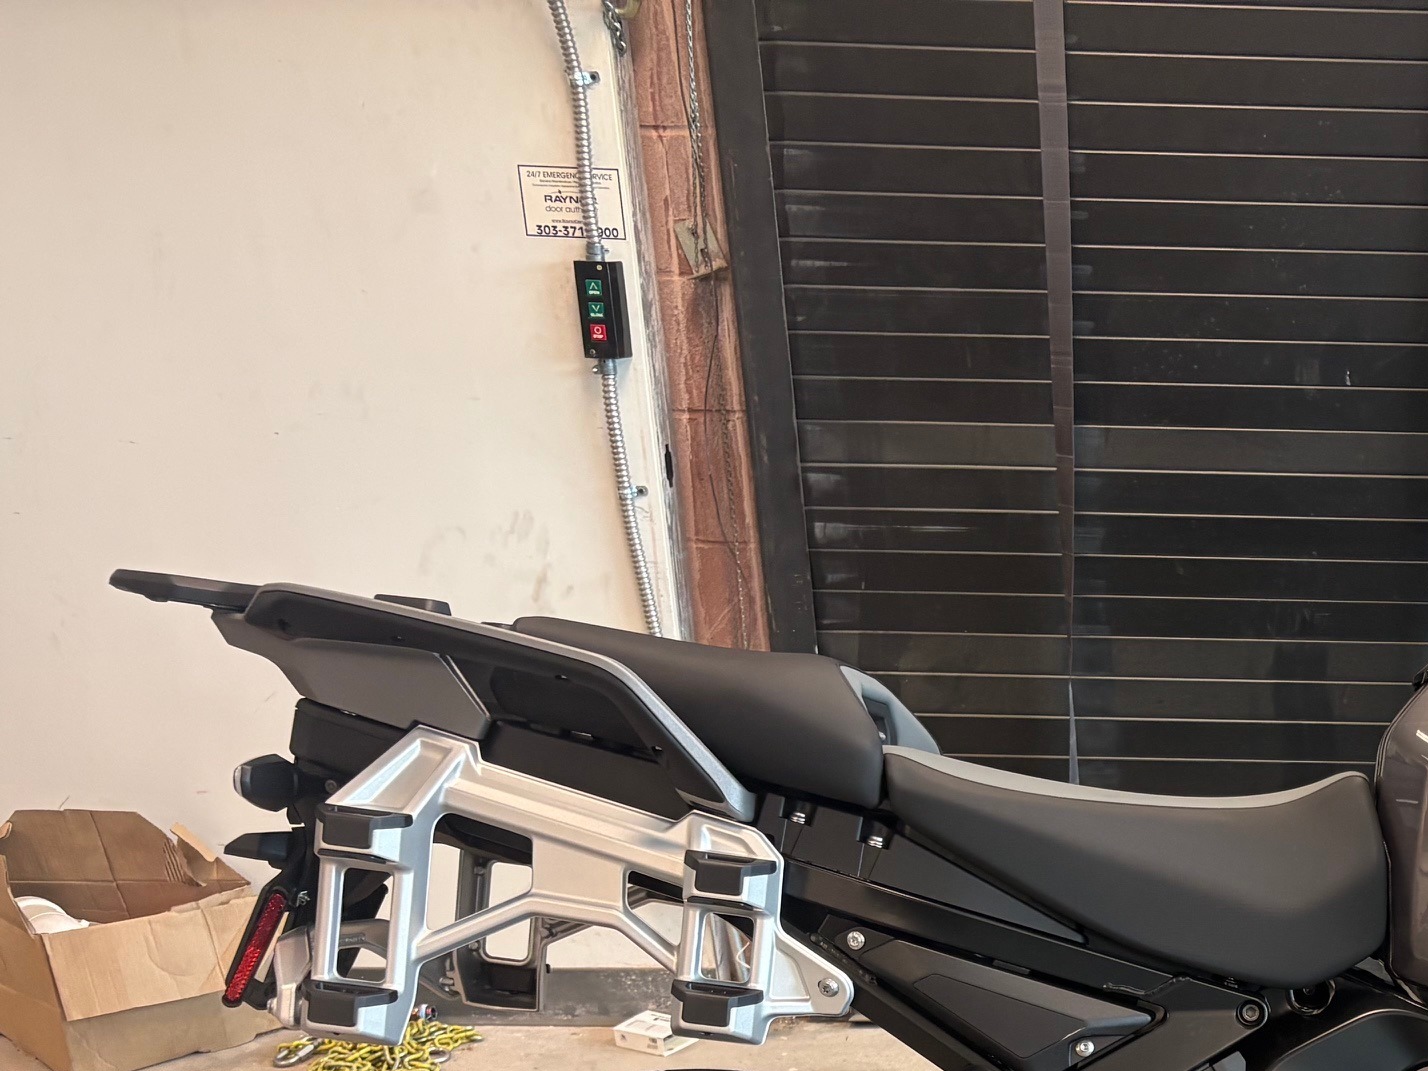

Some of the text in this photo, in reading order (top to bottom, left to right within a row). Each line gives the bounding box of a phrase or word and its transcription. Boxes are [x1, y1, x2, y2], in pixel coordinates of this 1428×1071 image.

[526, 170, 541, 178] 24/7
[543, 171, 580, 179] EMERGENC
[545, 204, 564, 213] door
